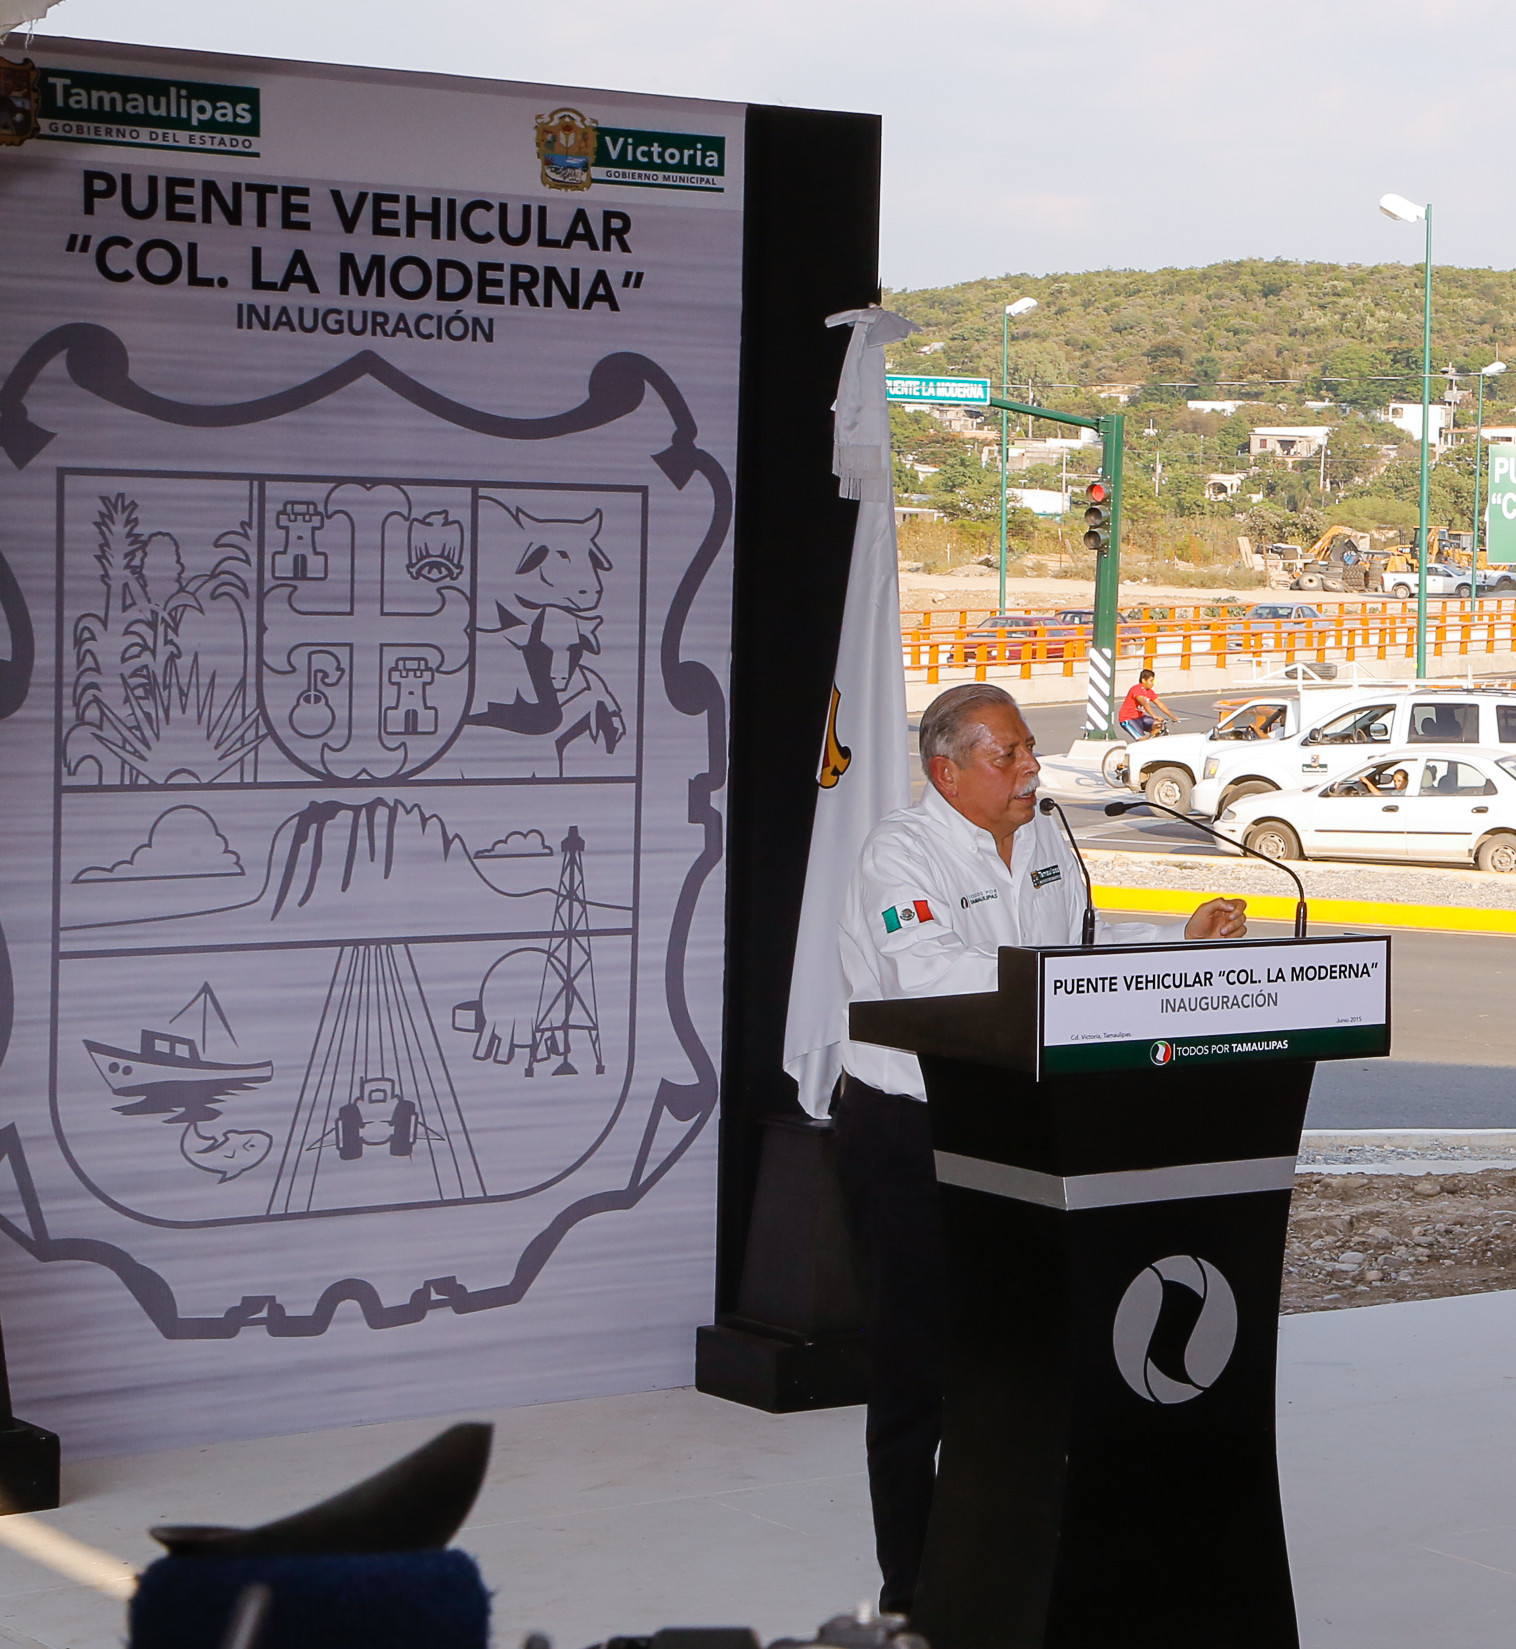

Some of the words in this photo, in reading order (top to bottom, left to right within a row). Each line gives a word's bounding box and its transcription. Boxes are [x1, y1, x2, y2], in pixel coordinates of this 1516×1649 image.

[48, 77, 252, 126] Tamaulipas
[48, 122, 140, 140] GOBIERNO
[150, 131, 180, 143] DEL
[188, 134, 253, 149] ESTADO
[604, 136, 719, 168] Victoria
[605, 170, 659, 182] GOBIERNO
[662, 174, 717, 186] MUNICIPAL
[82, 169, 311, 232] PUENTE
[329, 189, 632, 254] VEHICULAR
[252, 248, 319, 295] LA
[236, 303, 494, 343] INAUGURACIÓN
[921, 381, 936, 397] LA
[936, 382, 985, 399] MODERNA
[1053, 977, 1118, 996] PUENTE
[1123, 971, 1214, 991] VEHICULAR
[1266, 967, 1286, 984] LA
[1160, 990, 1278, 1013] INAUGURACIÓN
[1177, 1043, 1209, 1057] TODOS
[1211, 1042, 1230, 1054] POR
[1231, 1039, 1289, 1053] TAMAULIPAS
